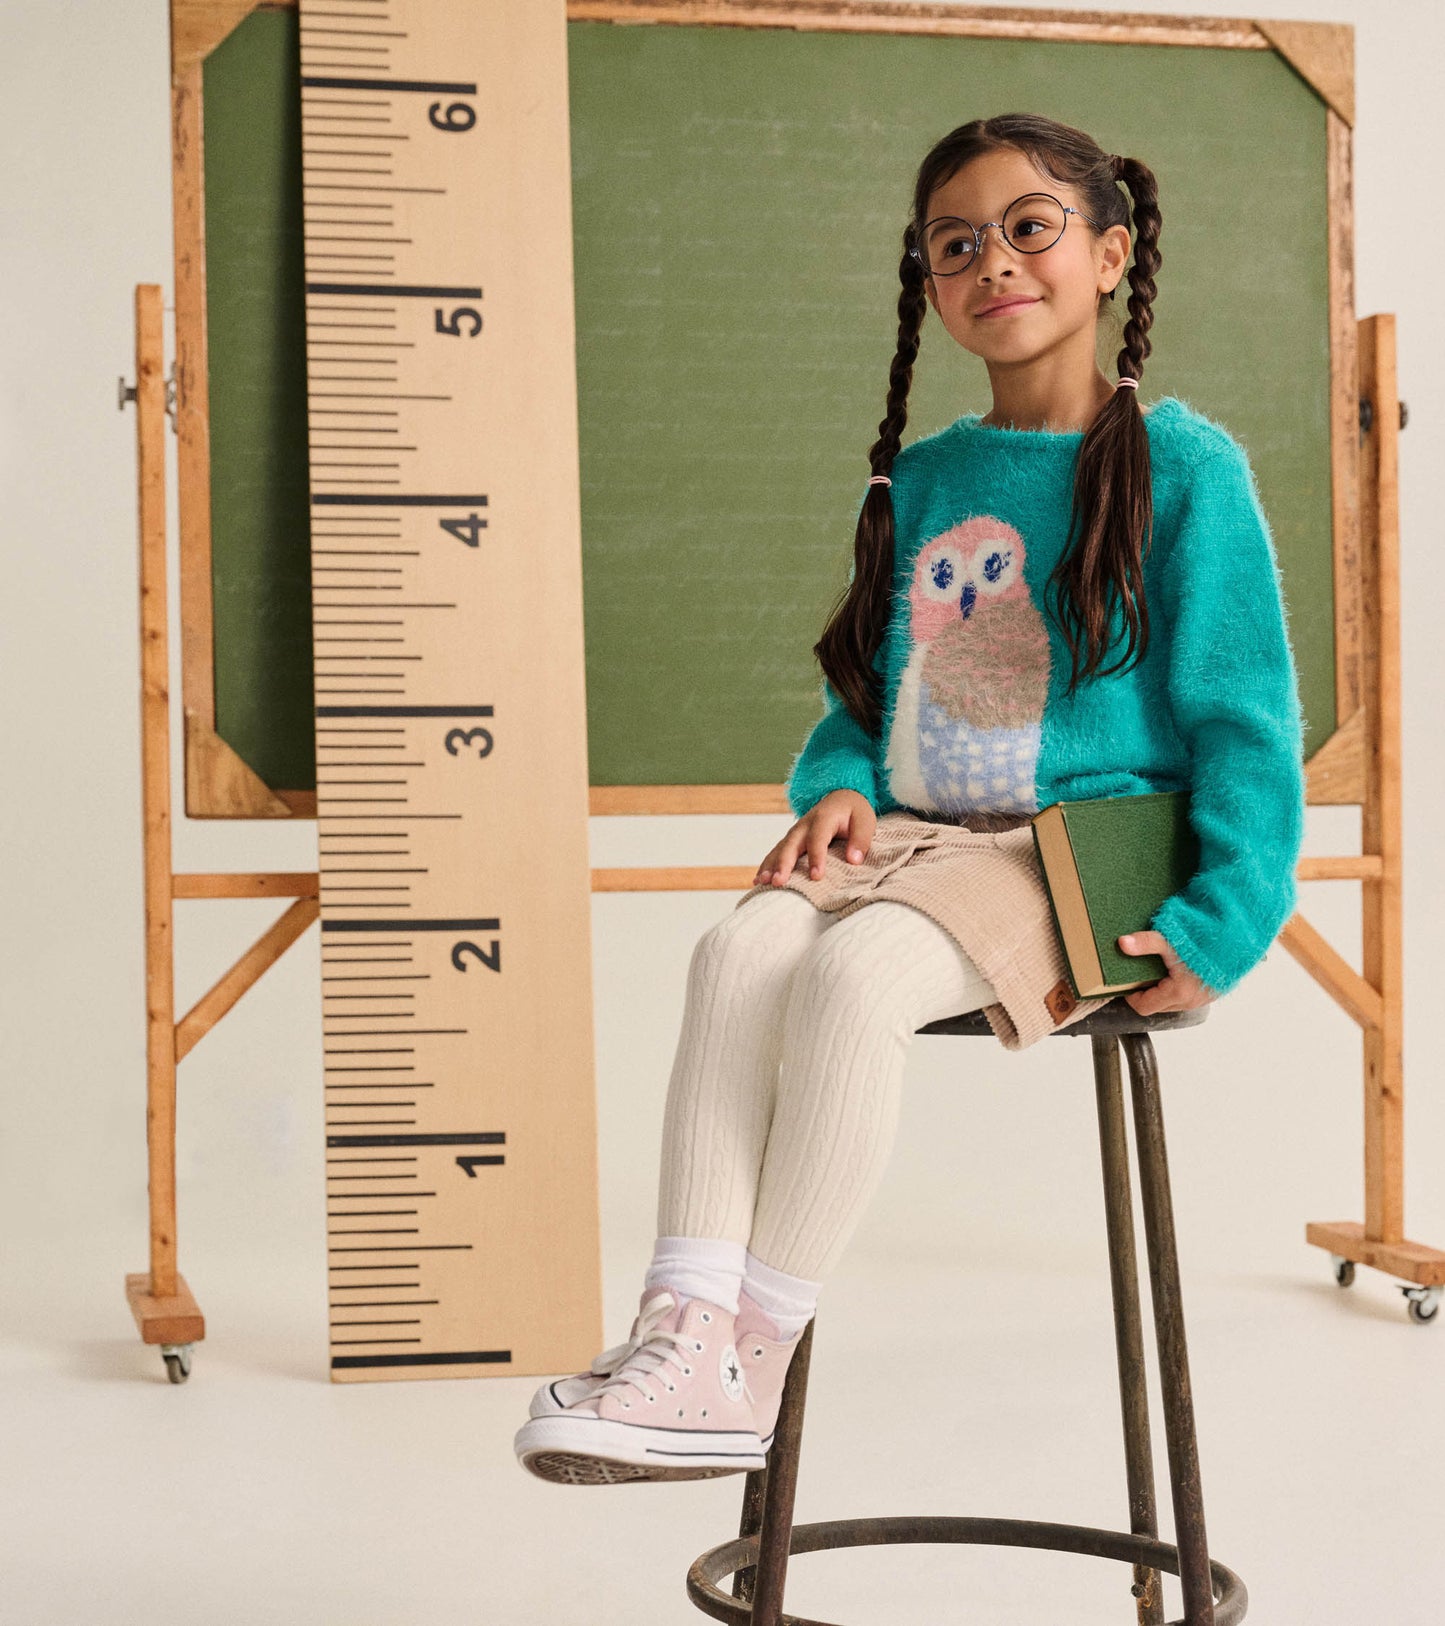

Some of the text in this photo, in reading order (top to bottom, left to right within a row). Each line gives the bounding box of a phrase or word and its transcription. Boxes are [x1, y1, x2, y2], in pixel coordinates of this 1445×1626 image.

[428, 102, 477, 132] 6
[435, 307, 483, 338] 5
[439, 513, 488, 548] 4
[444, 727, 494, 758] 3
[451, 940, 501, 973] 2
[455, 1154, 505, 1178] 1
